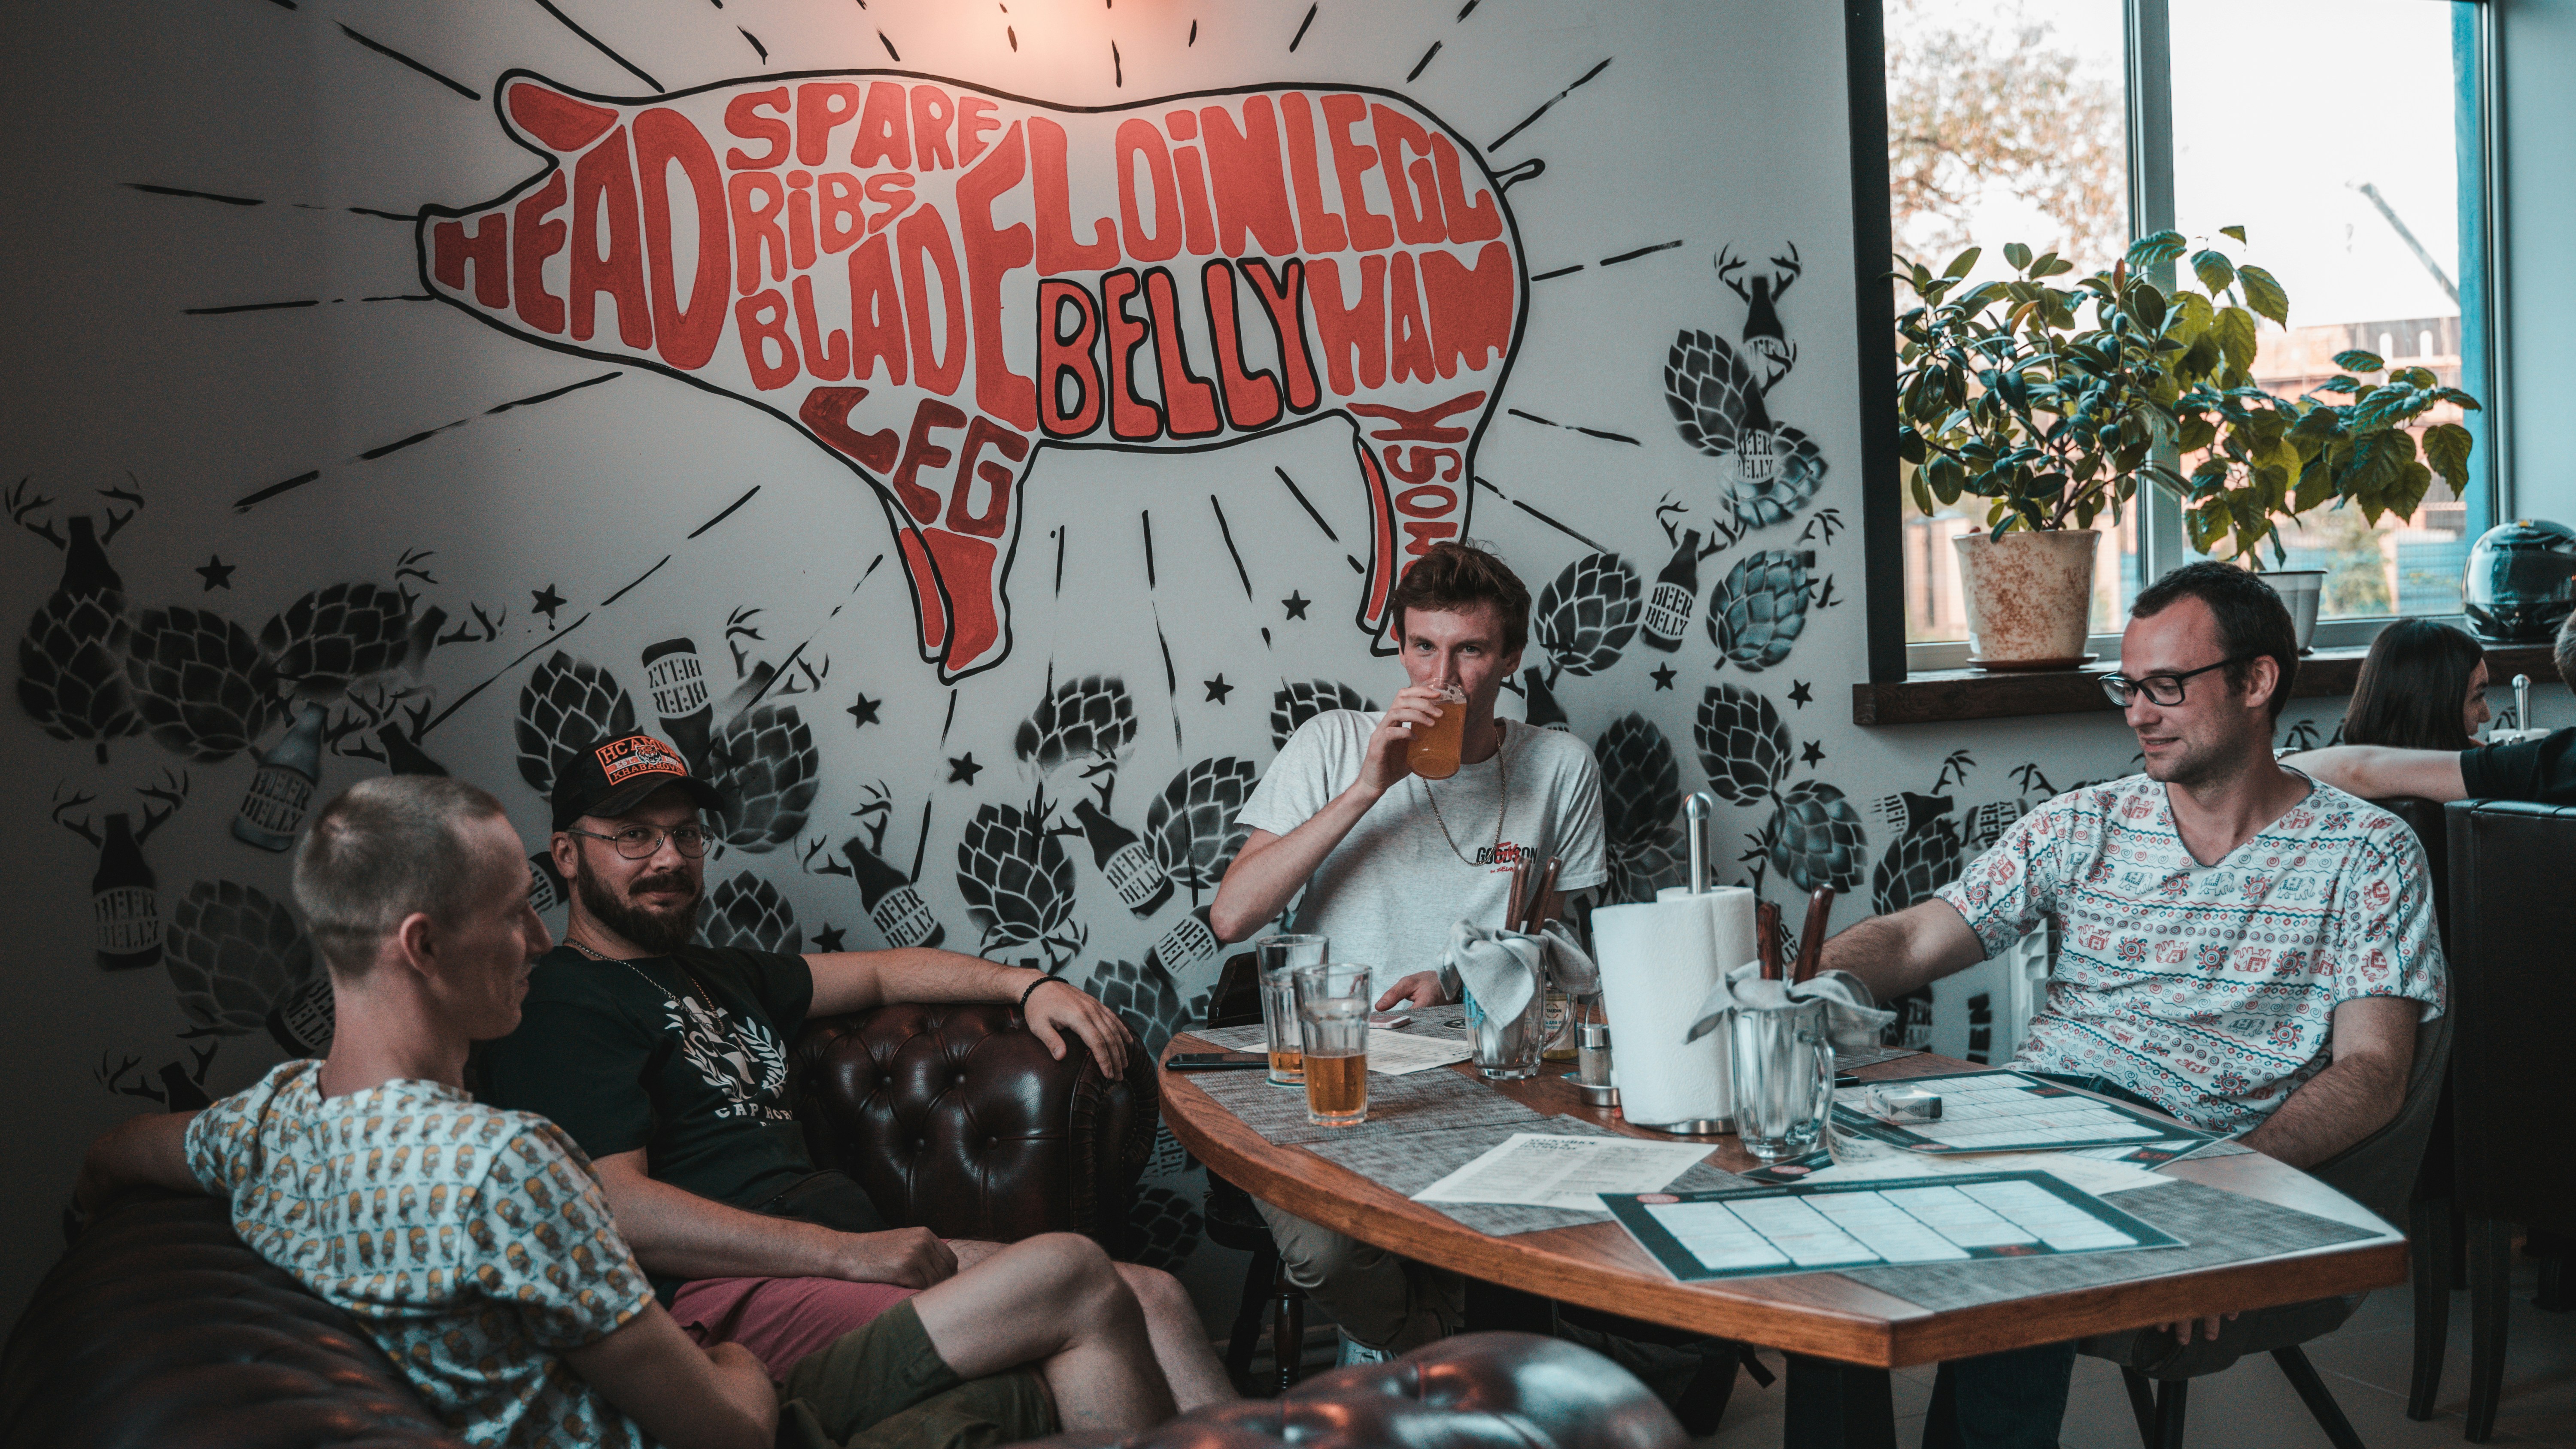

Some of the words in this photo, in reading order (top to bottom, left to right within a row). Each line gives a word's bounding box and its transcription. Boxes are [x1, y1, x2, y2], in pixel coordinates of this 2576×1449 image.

[724, 82, 1001, 172] SPARE
[434, 107, 731, 370] HEAD
[735, 119, 1037, 432] BLADE
[1304, 241, 1514, 397] HAM
[1036, 257, 1322, 443] BELLY
[799, 386, 1029, 539] LEG
[1645, 606, 1688, 636] BELLY
[1651, 586, 1692, 618] BEER
[601, 742, 628, 764] HC
[1106, 845, 1153, 890] BEER
[873, 888, 925, 934] BEER
[885, 906, 934, 948] BELLY
[715, 1103, 759, 1118] CAP
[1900, 1104, 1927, 1113] KENT
